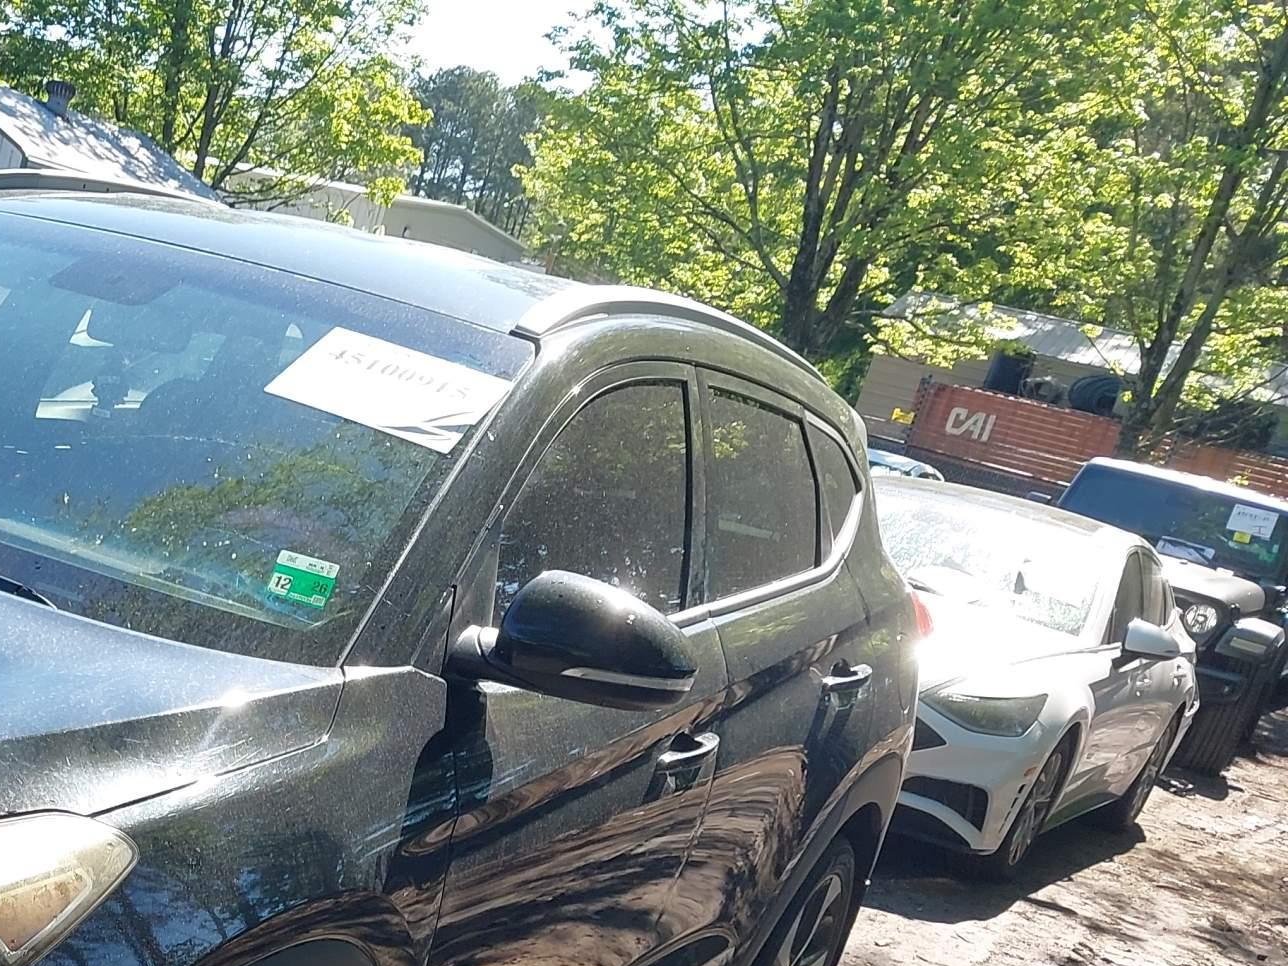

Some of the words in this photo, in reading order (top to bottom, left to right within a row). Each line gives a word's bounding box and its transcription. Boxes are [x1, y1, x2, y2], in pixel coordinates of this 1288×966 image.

[329, 349, 471, 400] 45100915
[945, 407, 996, 442] CAI
[274, 575, 292, 590] 12
[312, 581, 329, 593] 26
